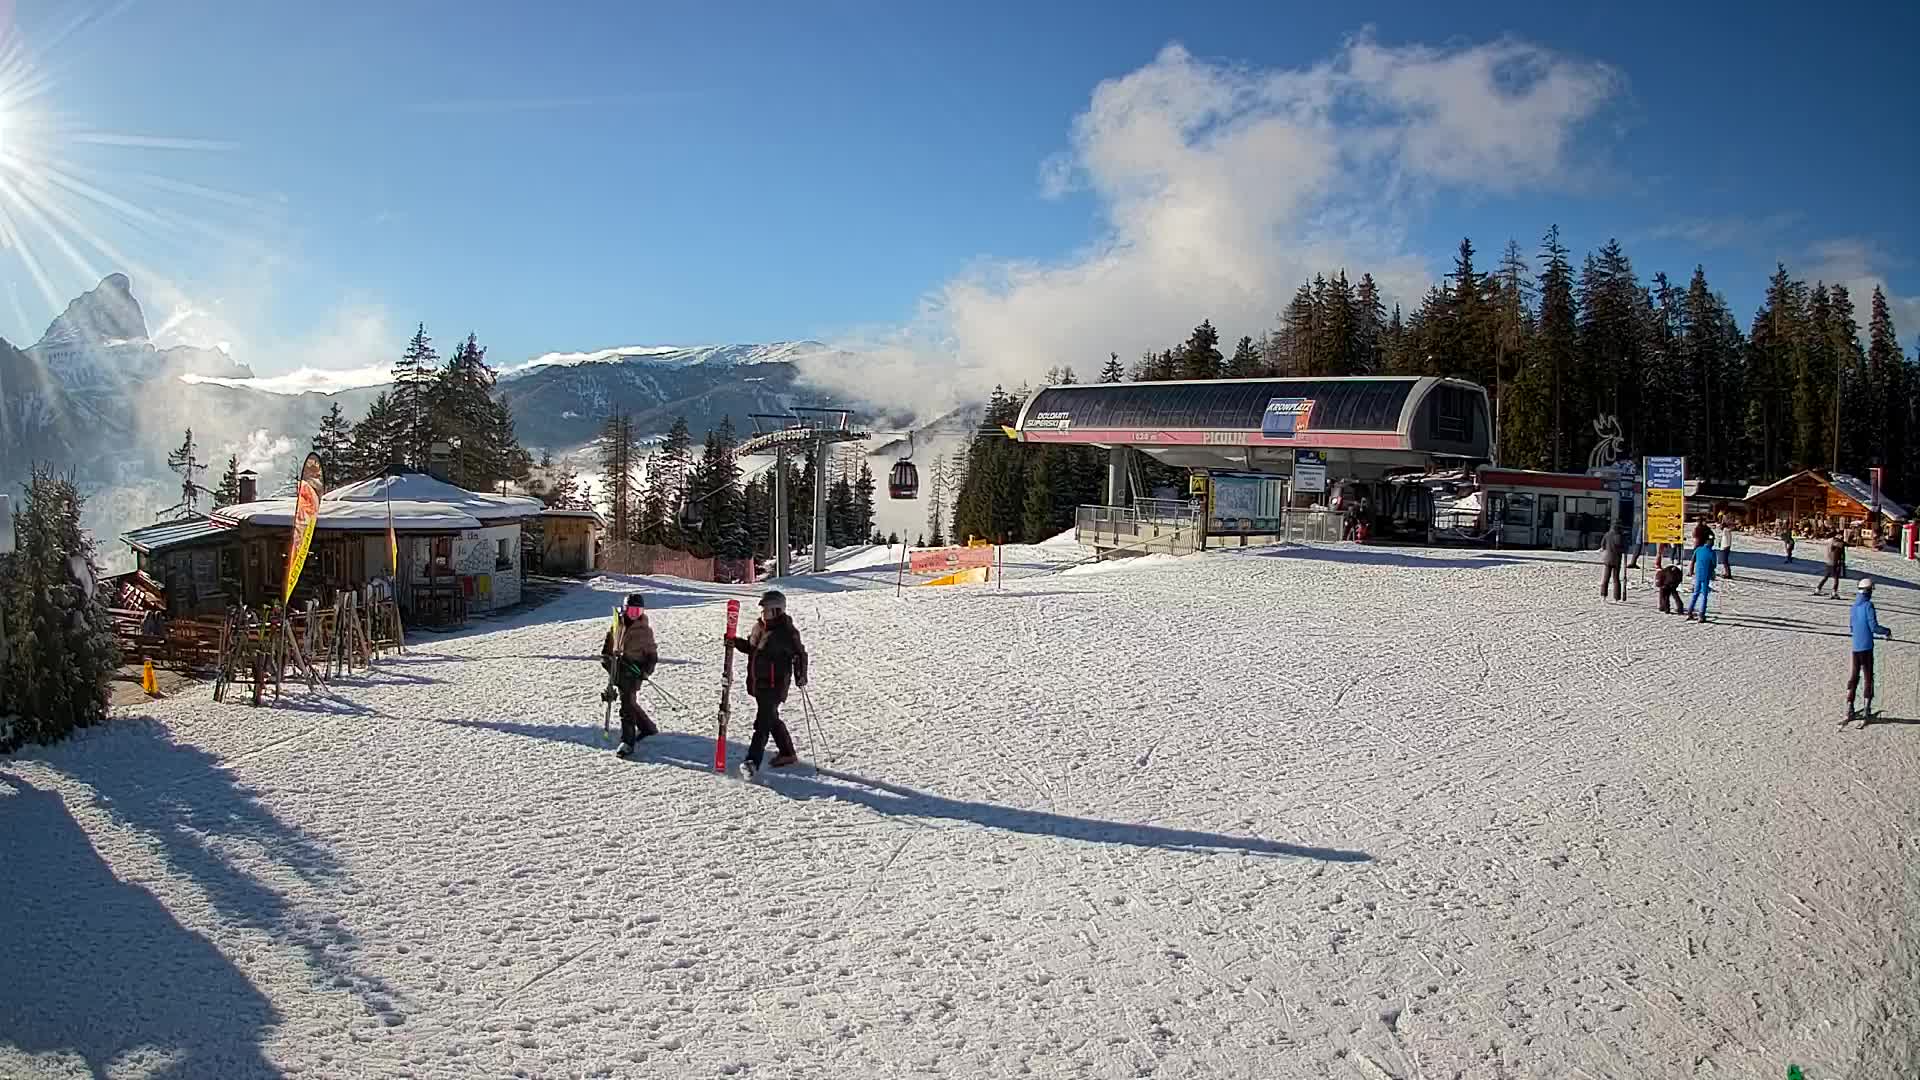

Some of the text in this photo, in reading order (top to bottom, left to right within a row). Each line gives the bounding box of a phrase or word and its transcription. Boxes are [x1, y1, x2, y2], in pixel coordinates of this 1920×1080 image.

[1267, 403, 1312, 411] KRONPLATZ
[1037, 412, 1069, 420] DOLOMITI
[1026, 419, 1059, 427] SUPERSKI
[1203, 431, 1248, 445] PICULIN
